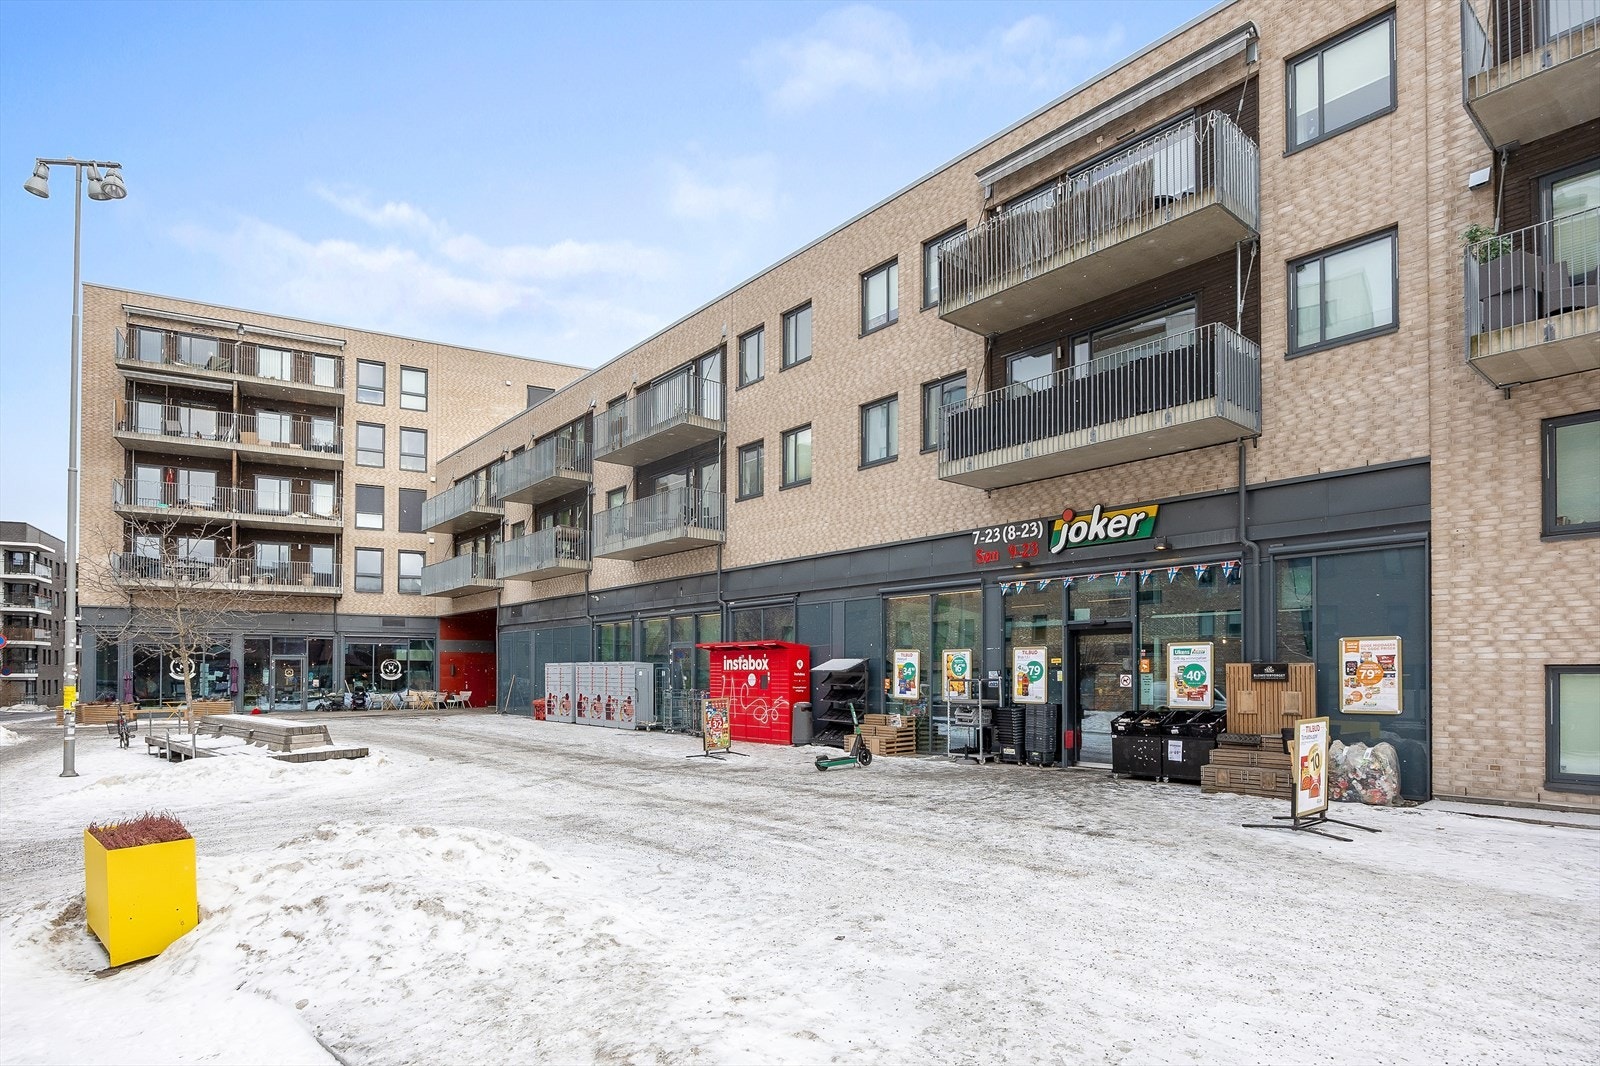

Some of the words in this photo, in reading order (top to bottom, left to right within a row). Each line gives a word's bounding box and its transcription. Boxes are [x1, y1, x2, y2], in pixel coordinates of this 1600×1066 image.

[972, 529, 1001, 545] 7-23
[1002, 521, 1044, 544] (8-23)
[1051, 504, 1146, 554] joker
[975, 549, 999, 564] Søn
[1008, 541, 1039, 560] 9-23
[723, 654, 769, 671] instabox
[1028, 665, 1041, 676] 79
[1305, 724, 1321, 733] TILBUD
[1310, 752, 1320, 771] 10
